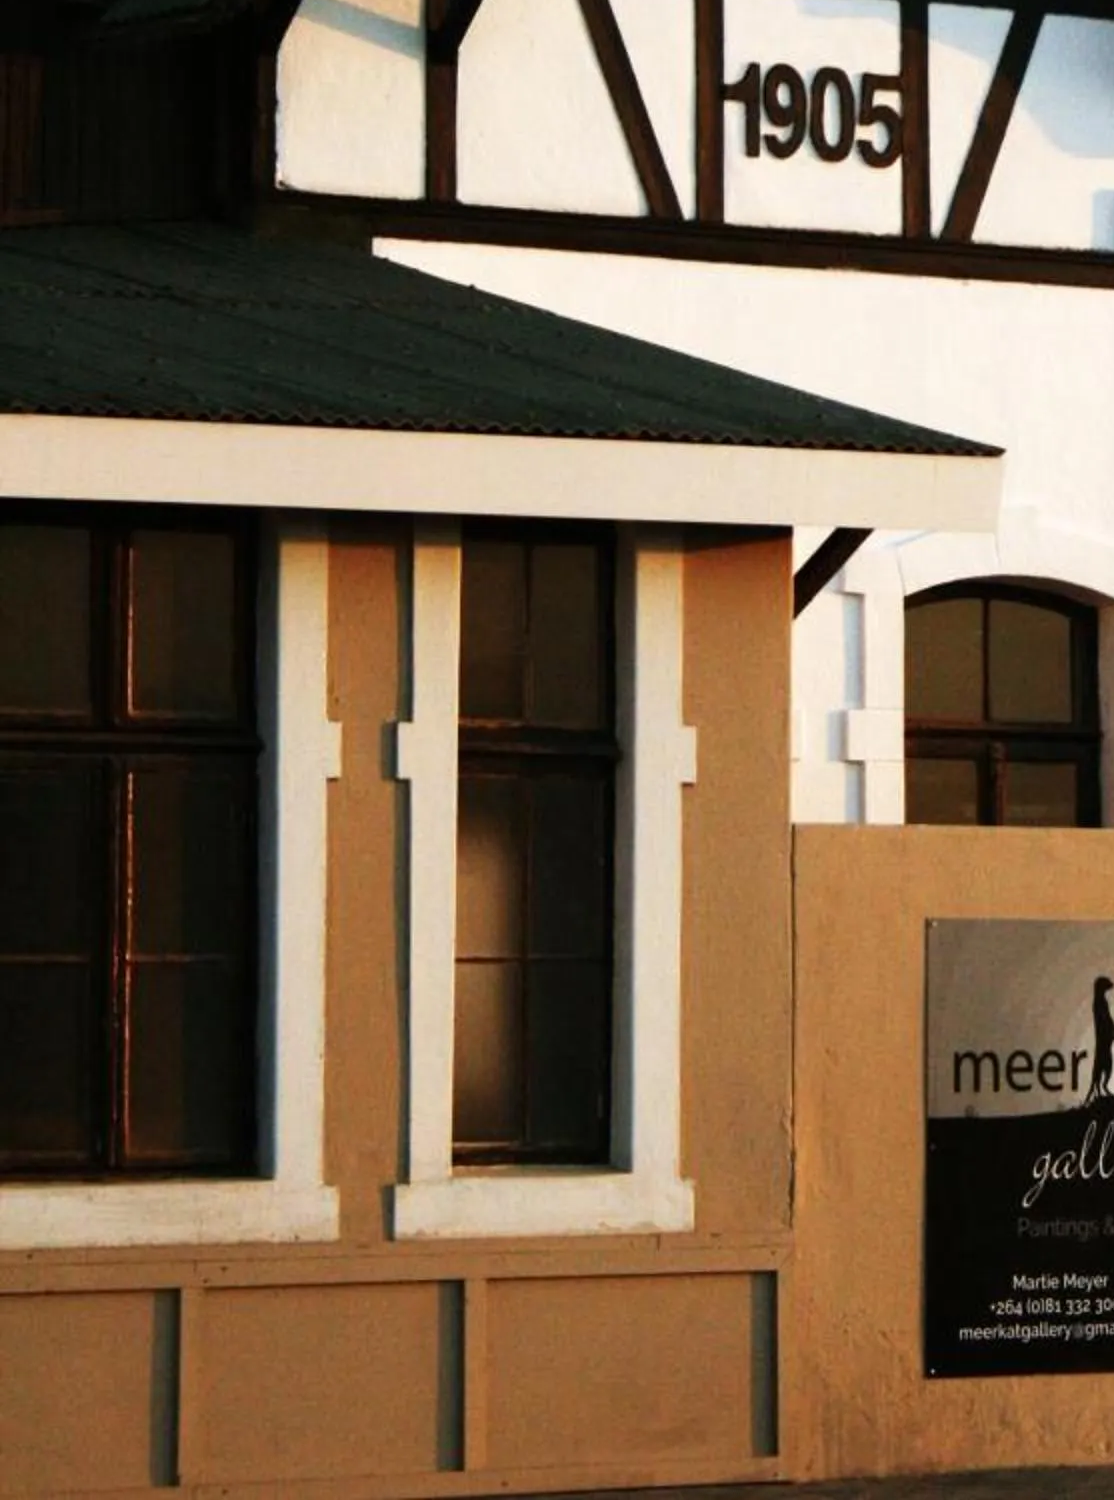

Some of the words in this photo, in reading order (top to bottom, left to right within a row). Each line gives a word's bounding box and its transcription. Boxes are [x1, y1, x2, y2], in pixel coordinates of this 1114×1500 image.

[722, 61, 902, 168] 1905
[1012, 1274, 1060, 1290] Martie
[1063, 1273, 1109, 1292] Meyer
[1065, 1299, 1091, 1315] 332
